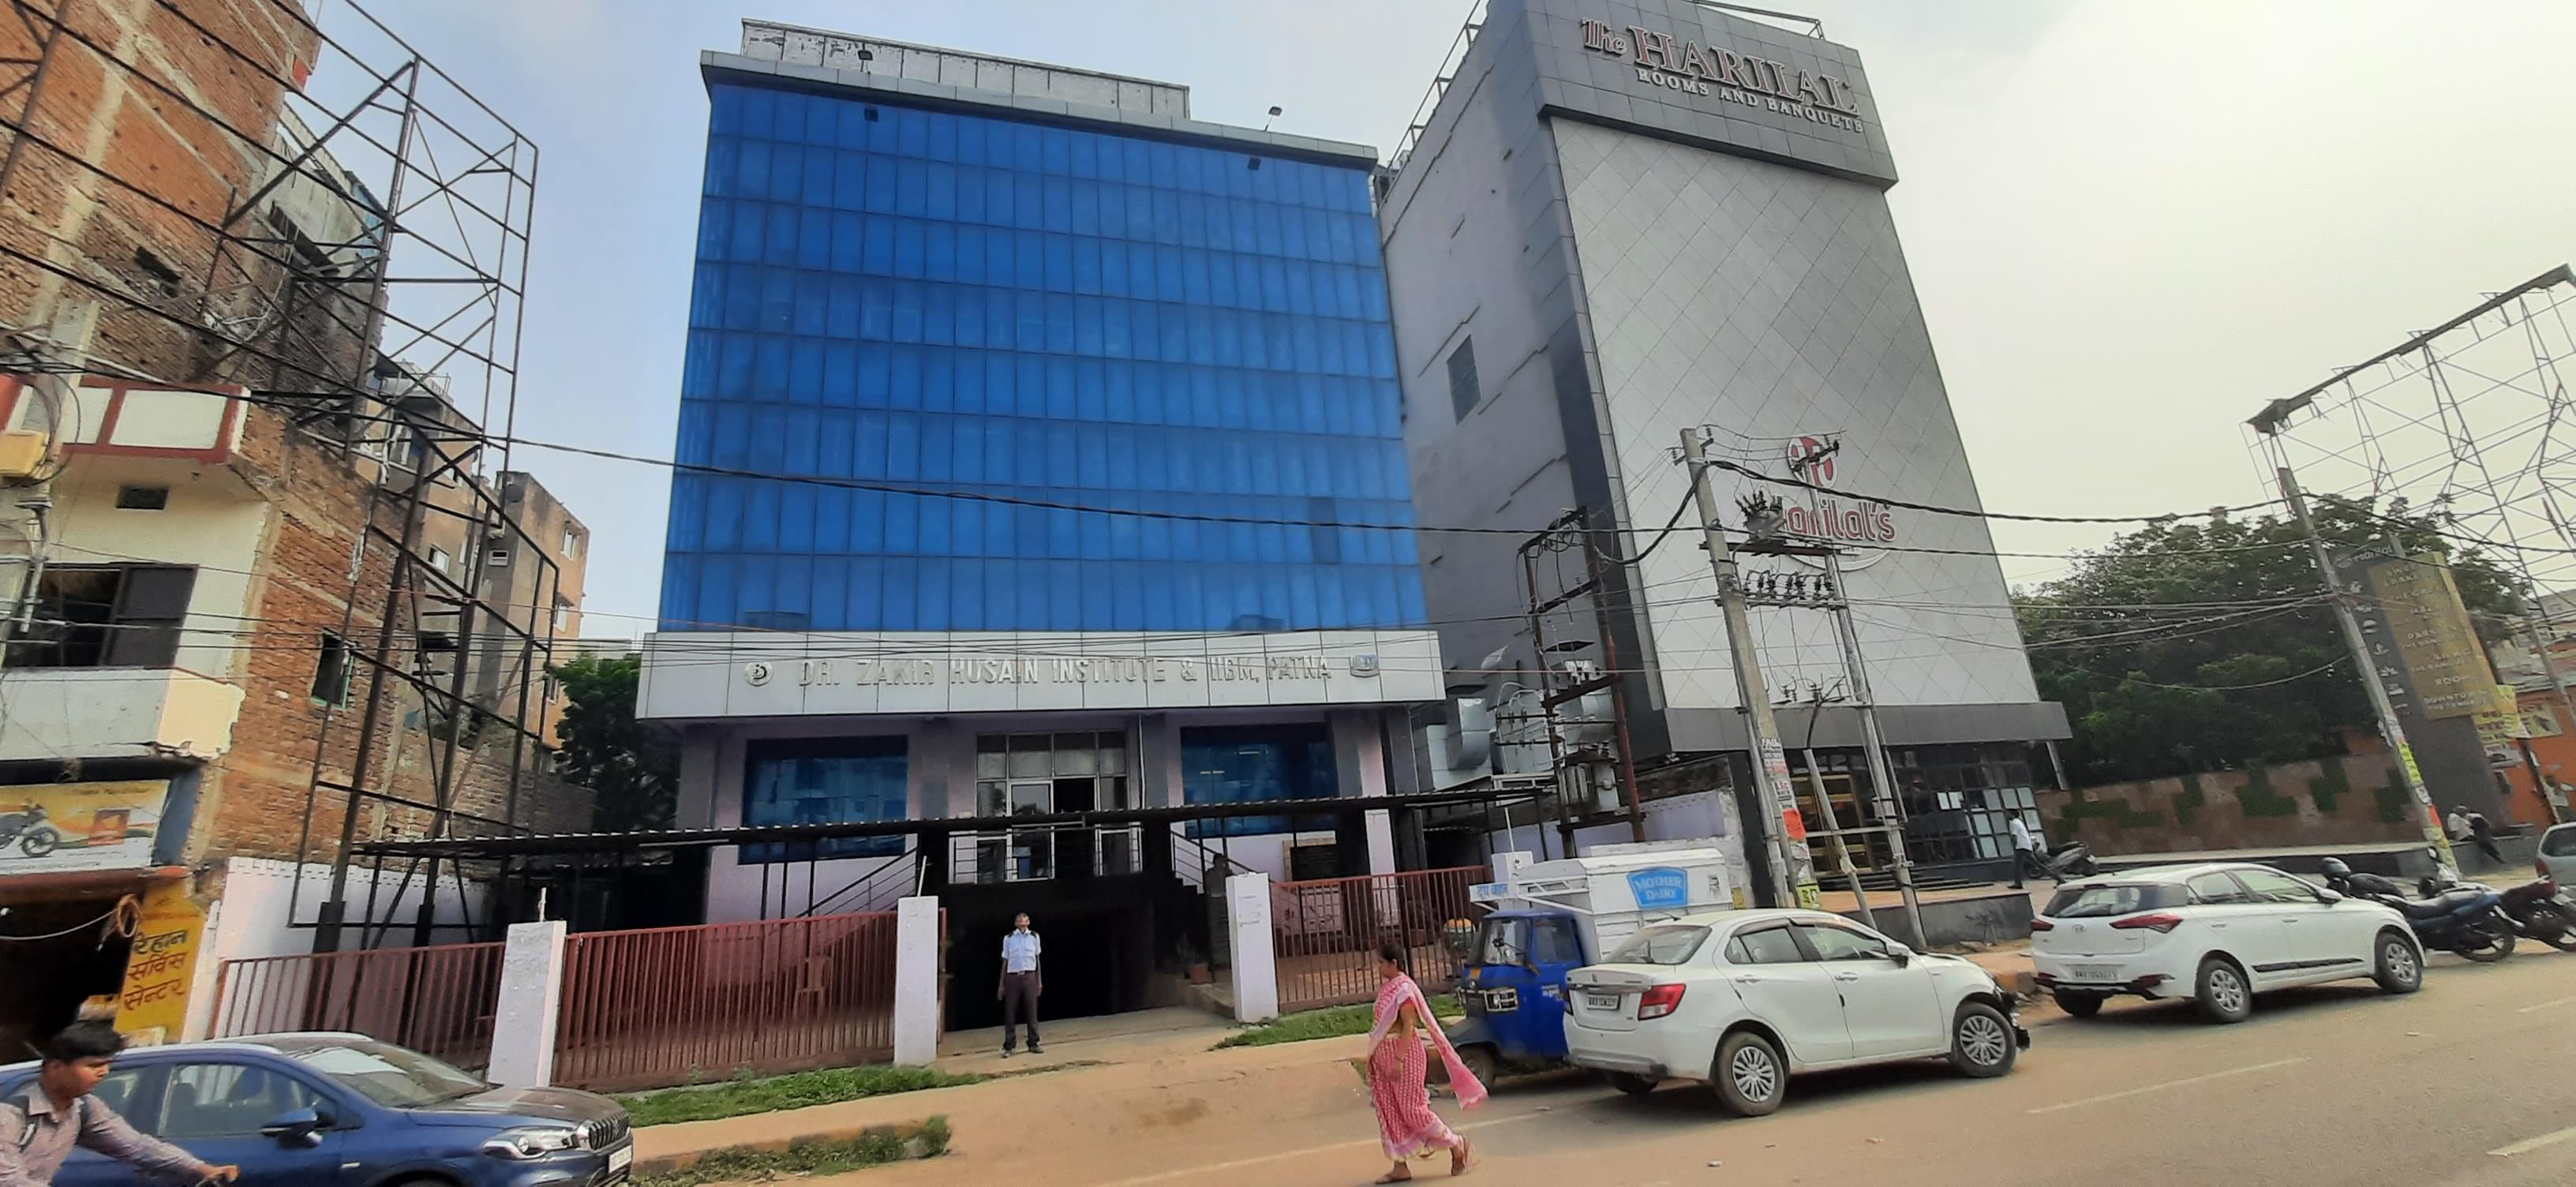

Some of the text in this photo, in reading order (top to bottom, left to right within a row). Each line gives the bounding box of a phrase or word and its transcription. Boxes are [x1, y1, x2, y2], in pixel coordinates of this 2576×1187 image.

[1580, 17, 1862, 118] The HARILAL
[1636, 68, 1863, 134] ROOMS AND BANQUETS
[799, 661, 841, 686] DR.
[856, 658, 935, 686] ZAKIR
[949, 657, 1040, 684] HUSAIN
[1051, 657, 1167, 683] INSTITUTE
[1180, 658, 1198, 682] &
[1267, 654, 1333, 680] PATNA
[1634, 875, 1683, 893] MOTHER
[1645, 887, 1676, 901] DAIRY
